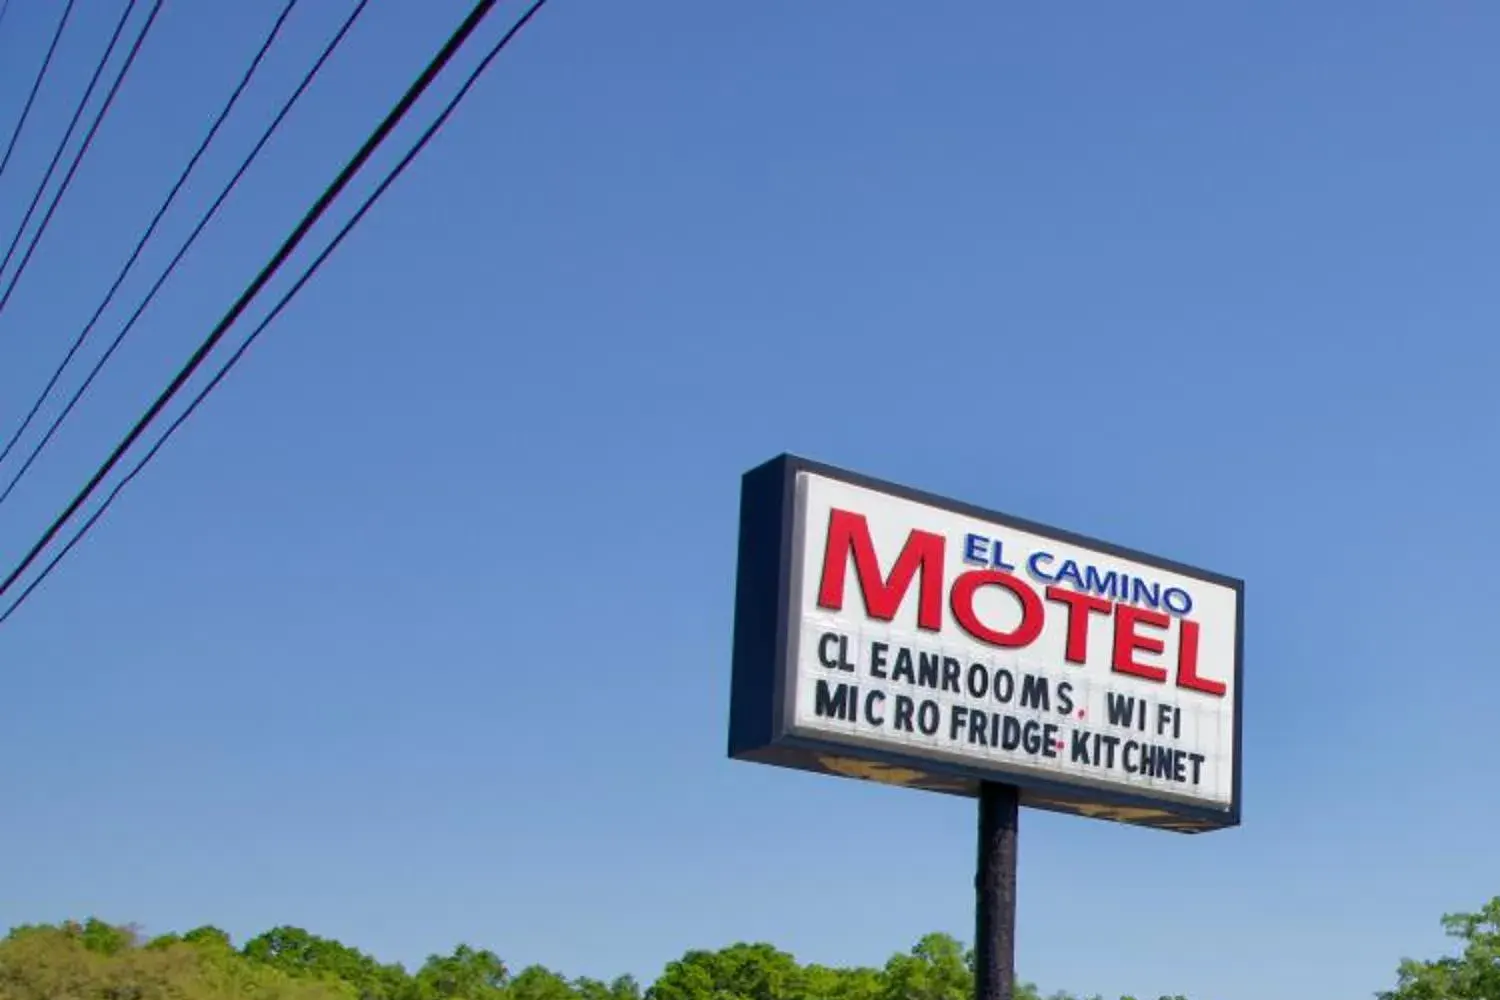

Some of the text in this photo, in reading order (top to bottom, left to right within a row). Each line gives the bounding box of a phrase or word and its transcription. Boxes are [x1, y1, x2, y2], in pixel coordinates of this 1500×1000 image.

[817, 506, 1227, 697] MOTEL
[964, 532, 1193, 614] EL CAMINO
